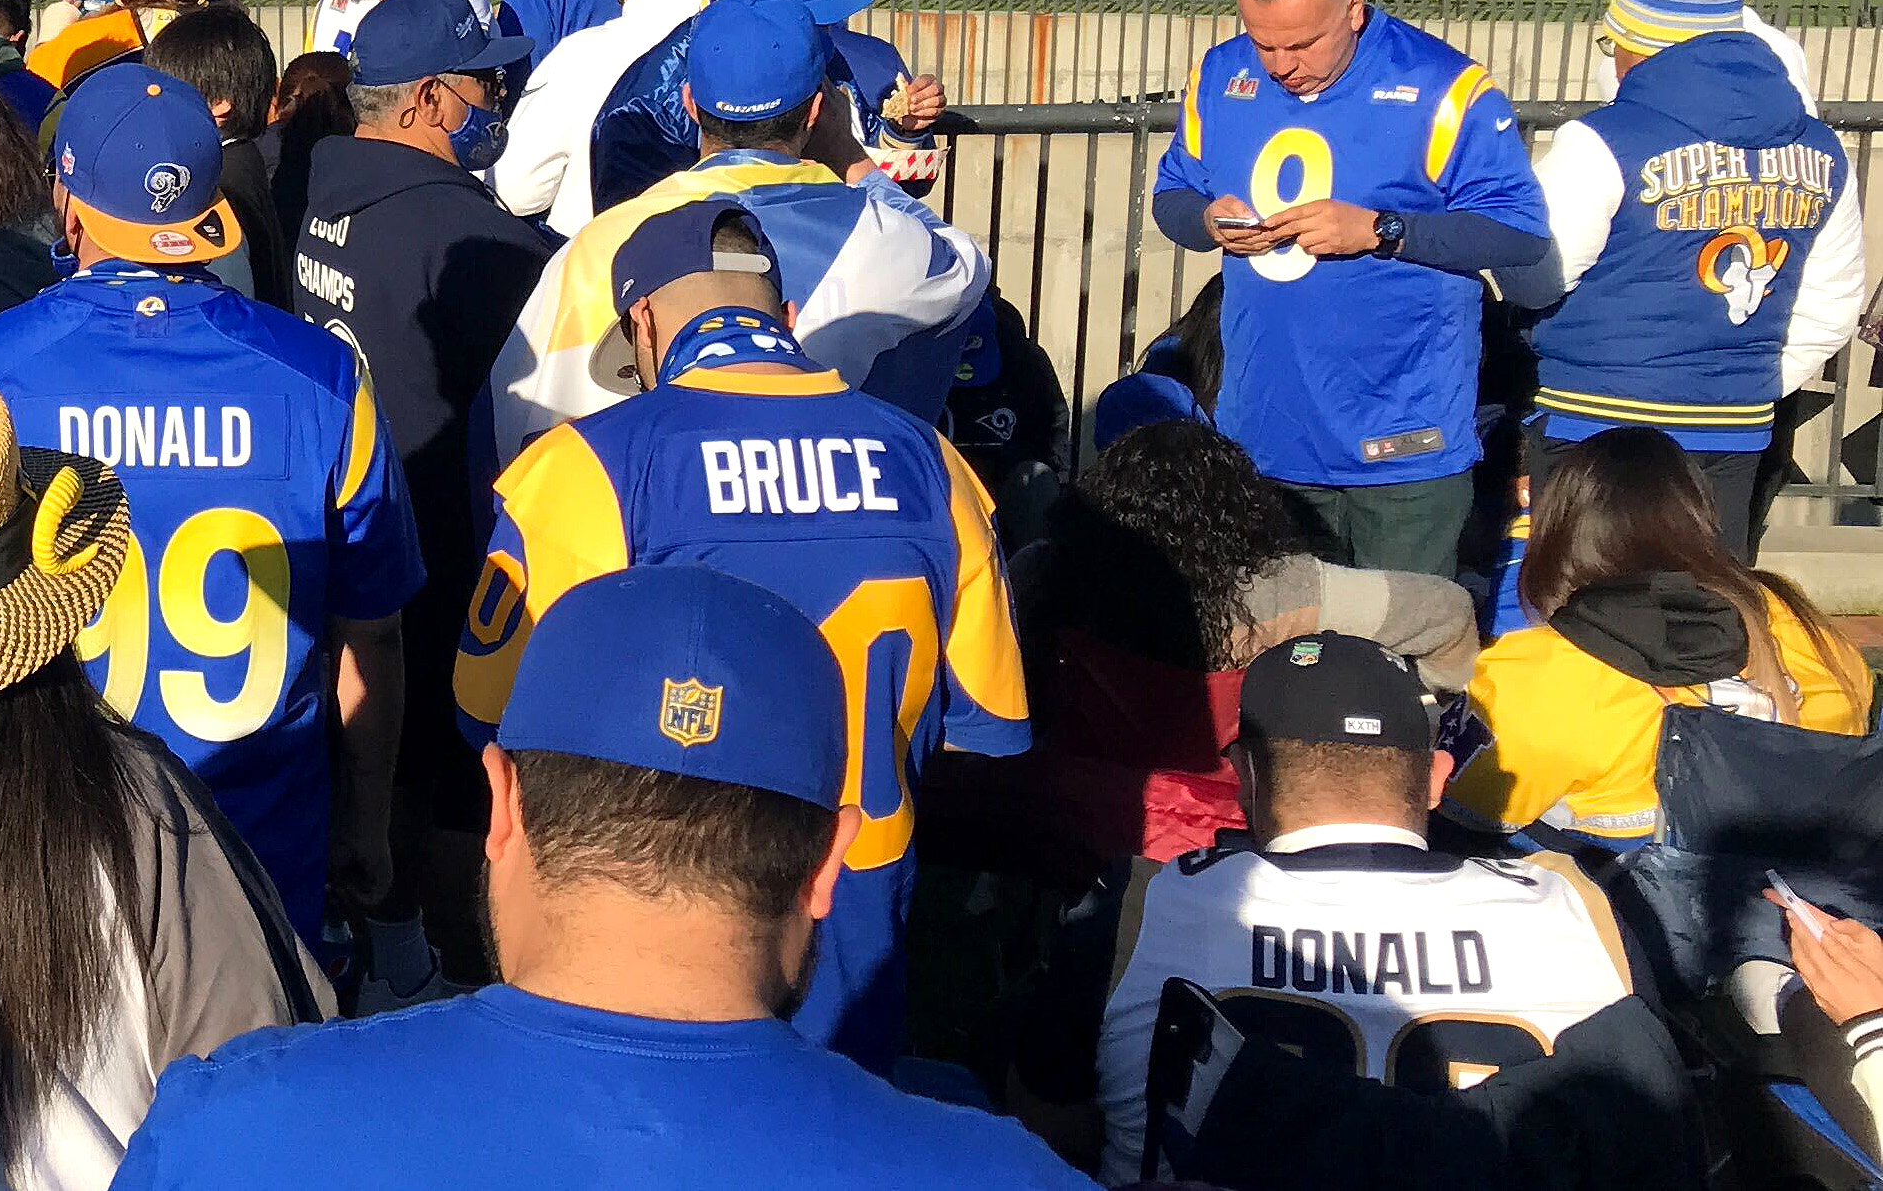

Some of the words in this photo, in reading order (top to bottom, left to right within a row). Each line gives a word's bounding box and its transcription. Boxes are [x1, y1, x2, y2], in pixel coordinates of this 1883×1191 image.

[1372, 89, 1418, 102] RAMS
[1640, 141, 1752, 204] SUPER
[1758, 143, 1835, 202] BOWL
[1656, 184, 1825, 231] CHAMPIONS
[297, 252, 355, 313] CHAMPS
[59, 406, 252, 467] DONALD
[700, 438, 899, 515] BRUCE
[666, 705, 715, 736] NFL
[1251, 924, 1493, 995] DONALD
